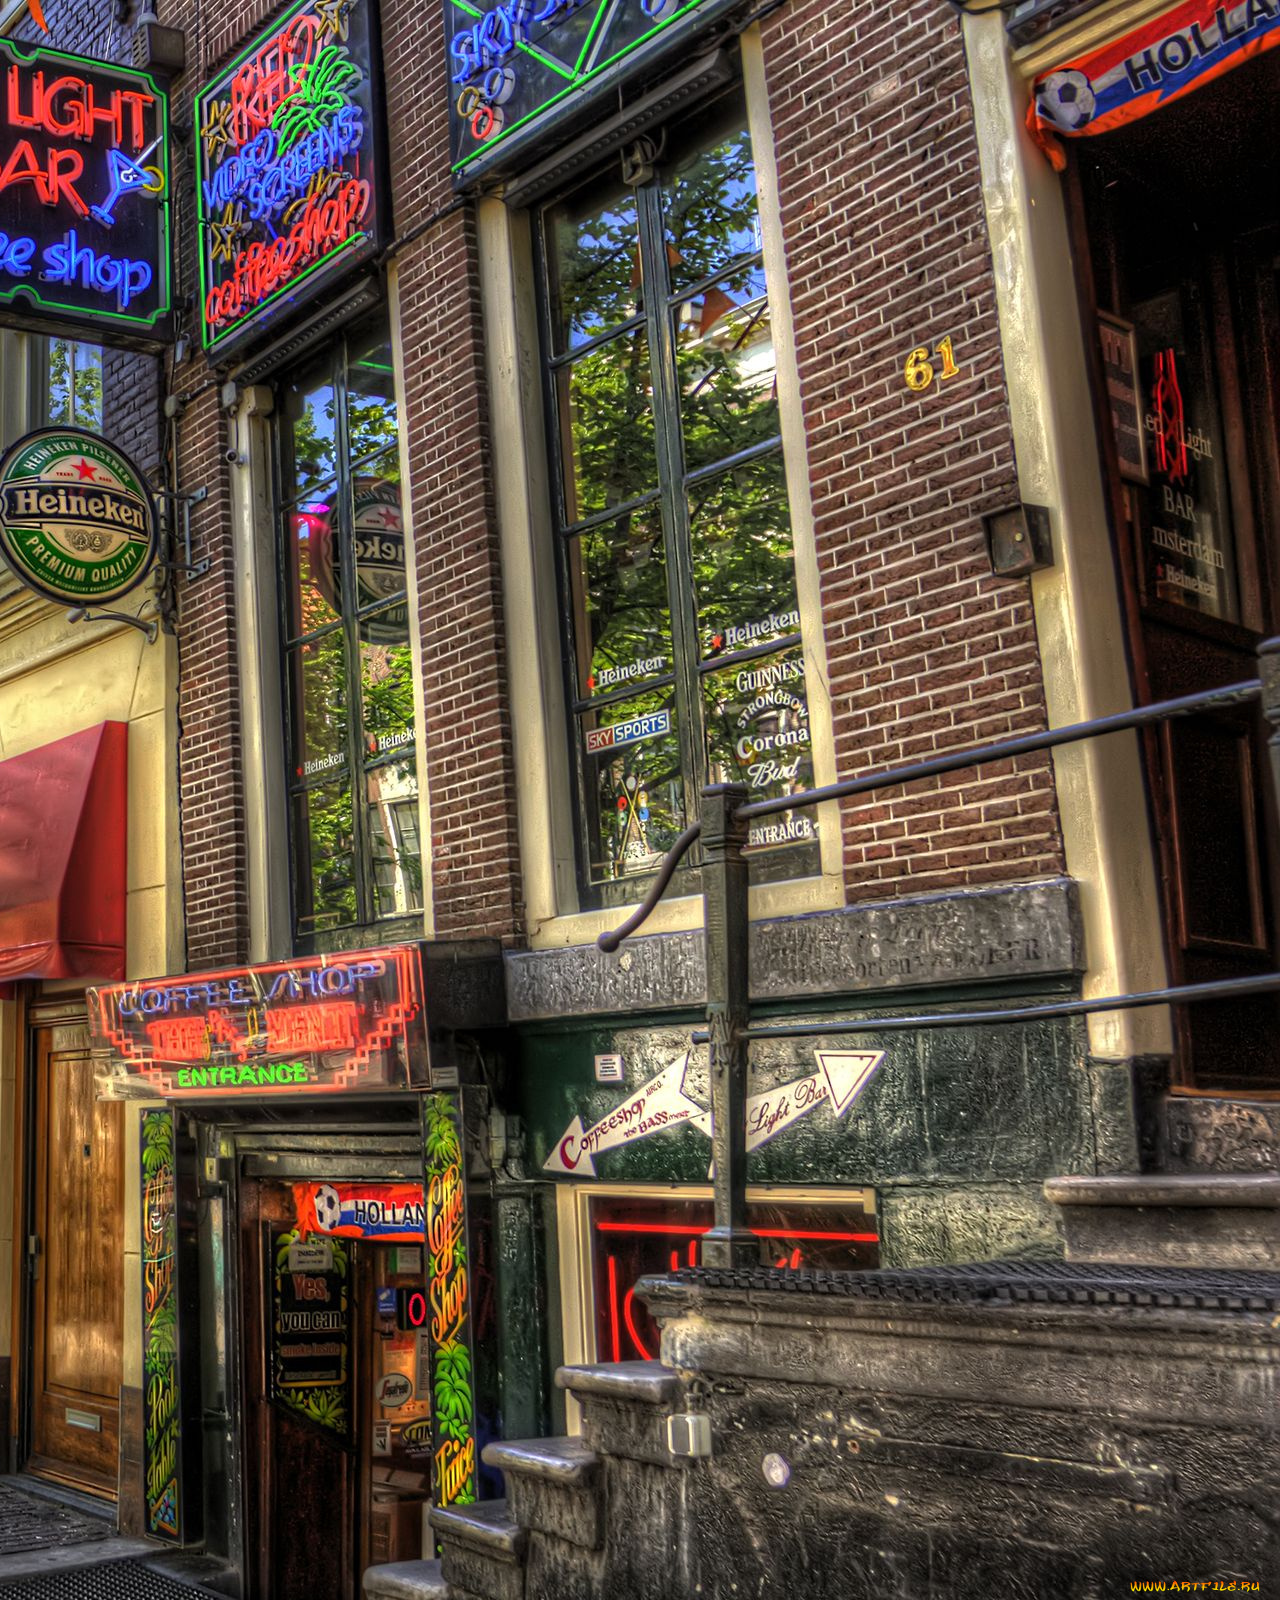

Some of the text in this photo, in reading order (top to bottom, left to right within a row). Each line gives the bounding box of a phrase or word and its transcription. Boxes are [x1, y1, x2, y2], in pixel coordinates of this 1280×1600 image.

[1123, 0, 1280, 92] HOLLA
[8, 65, 154, 154] LIGHT
[203, 128, 276, 208] VIDEO
[248, 105, 361, 221] SCREENS
[42, 229, 152, 307] shop
[904, 335, 960, 391] 61
[1143, 410, 1163, 436] ed
[23, 441, 131, 483] HEINEKEN PILSENER
[14, 488, 145, 530] Heineken
[1162, 483, 1197, 522] BAR
[25, 535, 87, 582] PREMIUM
[91, 546, 138, 582] QUALITY
[1151, 523, 1225, 569] msterdam
[1165, 563, 1219, 599] Heineken
[724, 609, 800, 647] Heineken
[597, 654, 664, 687] Heineken
[736, 657, 805, 693] GUINNESS
[736, 689, 810, 729] STRONGBOW
[378, 726, 417, 751] Heinek
[589, 716, 667, 750] SKY SPORTS
[736, 726, 810, 760] Corona
[303, 752, 345, 776] Heineken
[747, 755, 802, 788] Bud
[747, 818, 811, 846] ENTRANCE
[119, 979, 252, 1016] COFFEE
[177, 1062, 308, 1087] ENTRANCE
[748, 1078, 830, 1136] Light Bar
[354, 1200, 424, 1227] HOLLAN
[427, 1163, 465, 1276] Coffee
[292, 1273, 331, 1302] Yes,
[430, 1264, 468, 1344] Shop
[280, 1310, 341, 1333] you can
[147, 1363, 179, 1440] Pool
